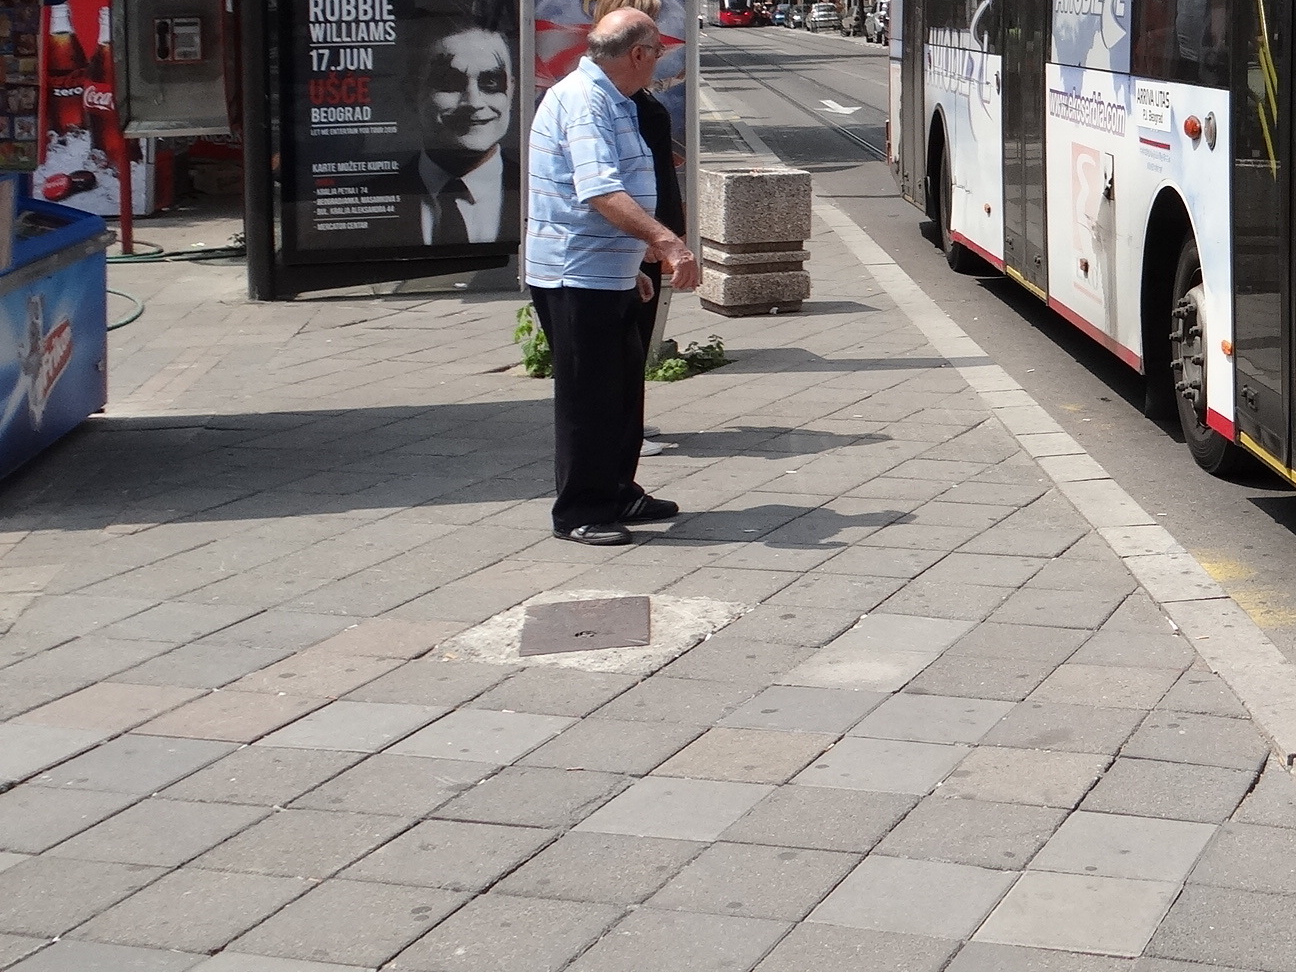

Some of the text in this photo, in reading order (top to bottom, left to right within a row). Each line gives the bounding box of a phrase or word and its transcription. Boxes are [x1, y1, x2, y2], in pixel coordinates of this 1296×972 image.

[309, 21, 396, 43] WILLIAMS
[309, 48, 374, 71] 17.JUN
[53, 87, 84, 97] zero
[311, 106, 372, 123] BEOGRAD
[312, 163, 337, 173] KARTE
